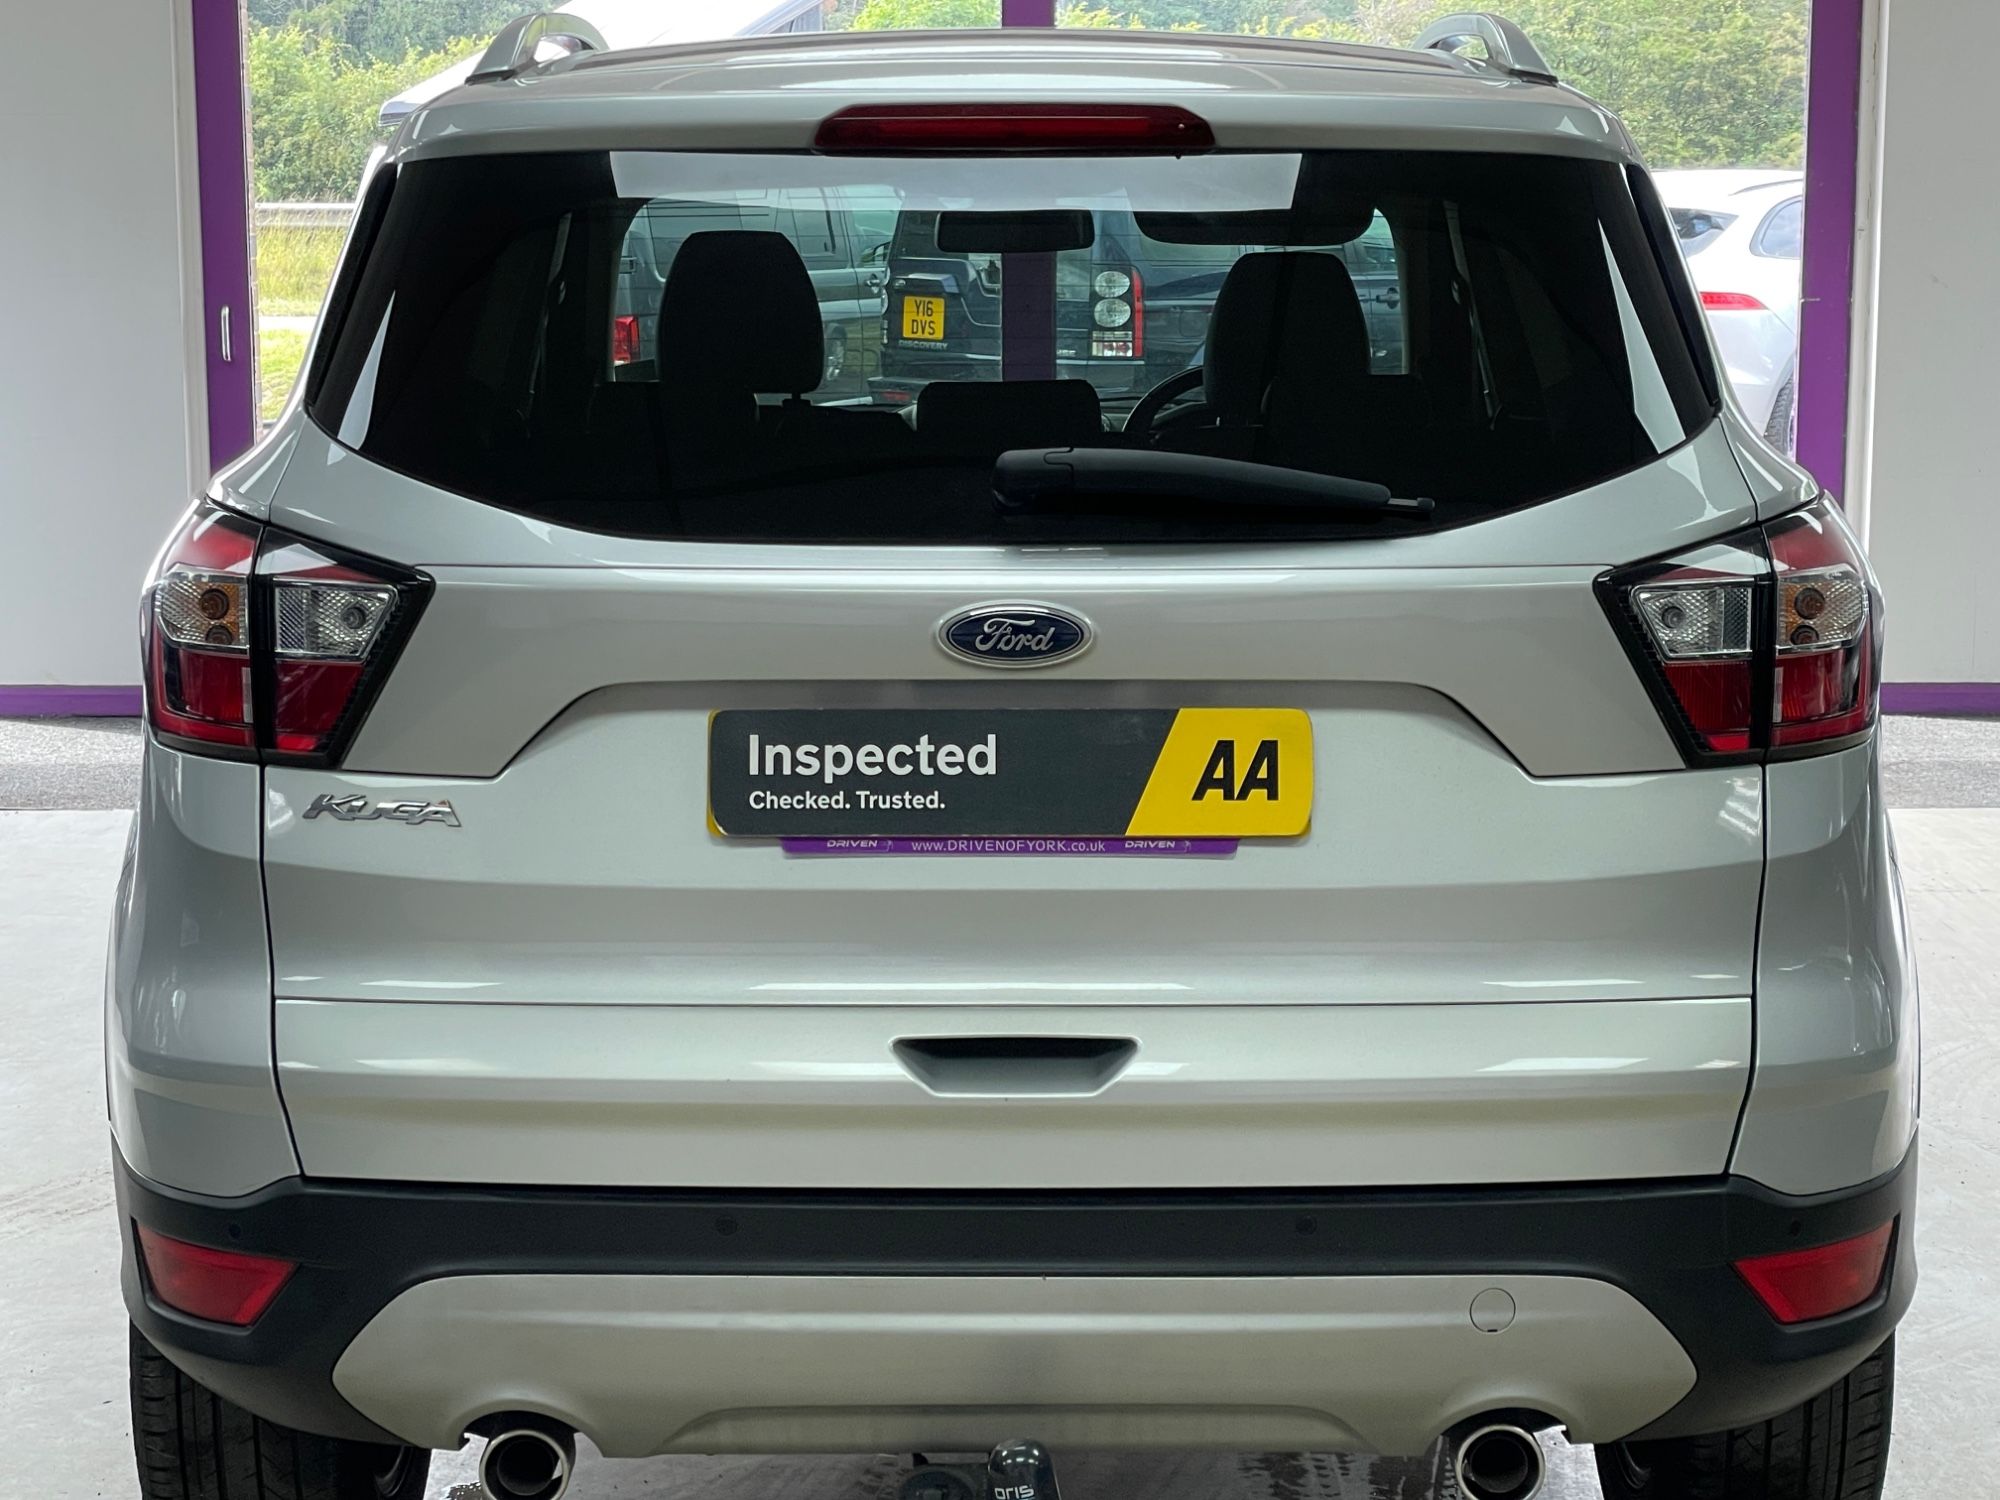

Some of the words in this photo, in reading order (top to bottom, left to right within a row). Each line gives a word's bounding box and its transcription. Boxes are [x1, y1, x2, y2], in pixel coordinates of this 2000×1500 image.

[914, 299, 934, 316] Y16
[911, 319, 936, 335] DVS
[975, 617, 1056, 651] Ford
[749, 734, 997, 784] Inspected
[1191, 739, 1279, 801] AA
[749, 790, 851, 810] Checked.
[855, 790, 946, 810] Trusted.
[827, 839, 878, 848] DRIVEN
[911, 840, 1106, 852] www.DRIVENOFYORK.co.uk
[1124, 840, 1176, 849] DRIVEN
